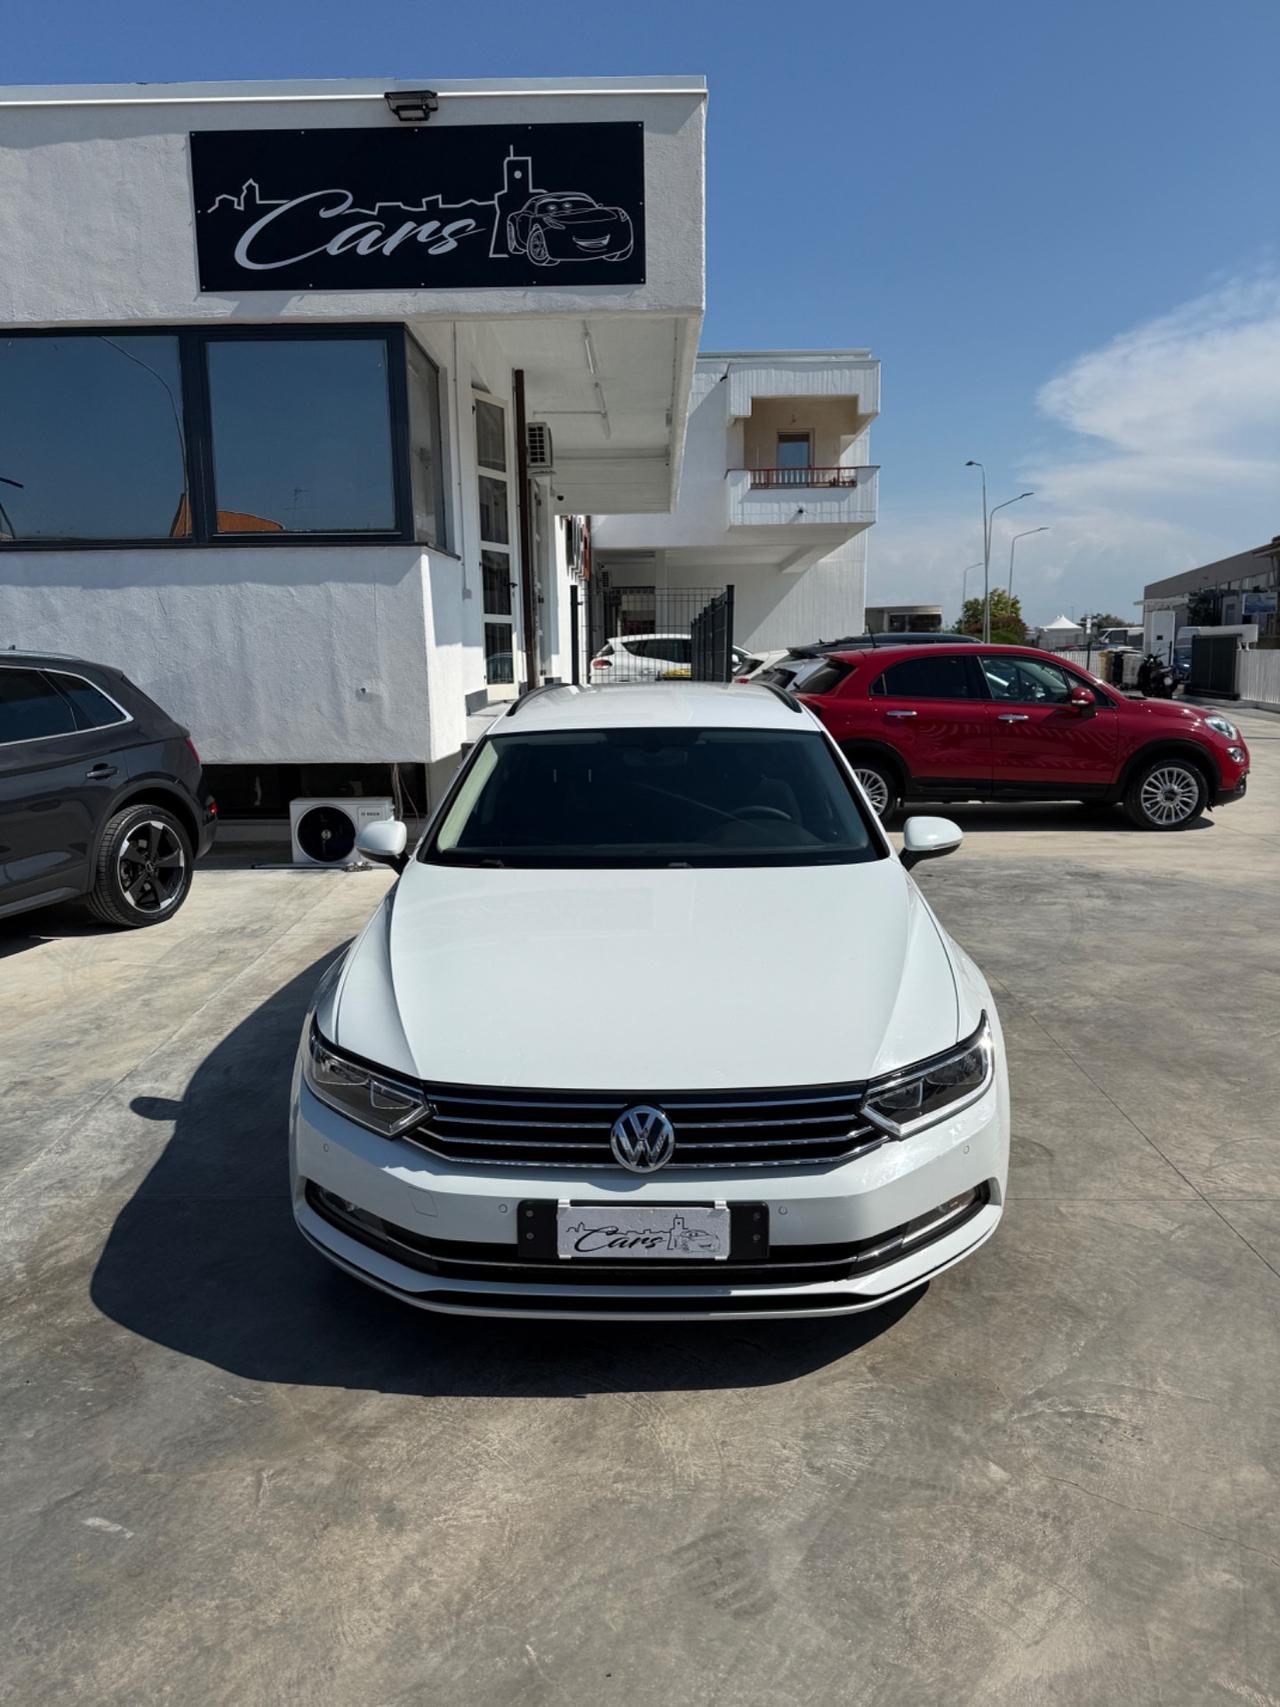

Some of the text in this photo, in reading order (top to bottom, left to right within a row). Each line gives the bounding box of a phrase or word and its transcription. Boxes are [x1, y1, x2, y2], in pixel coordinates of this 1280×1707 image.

[234, 189, 486, 270] Cars
[611, 1106, 674, 1172] VW
[574, 1226, 666, 1252] Cars
